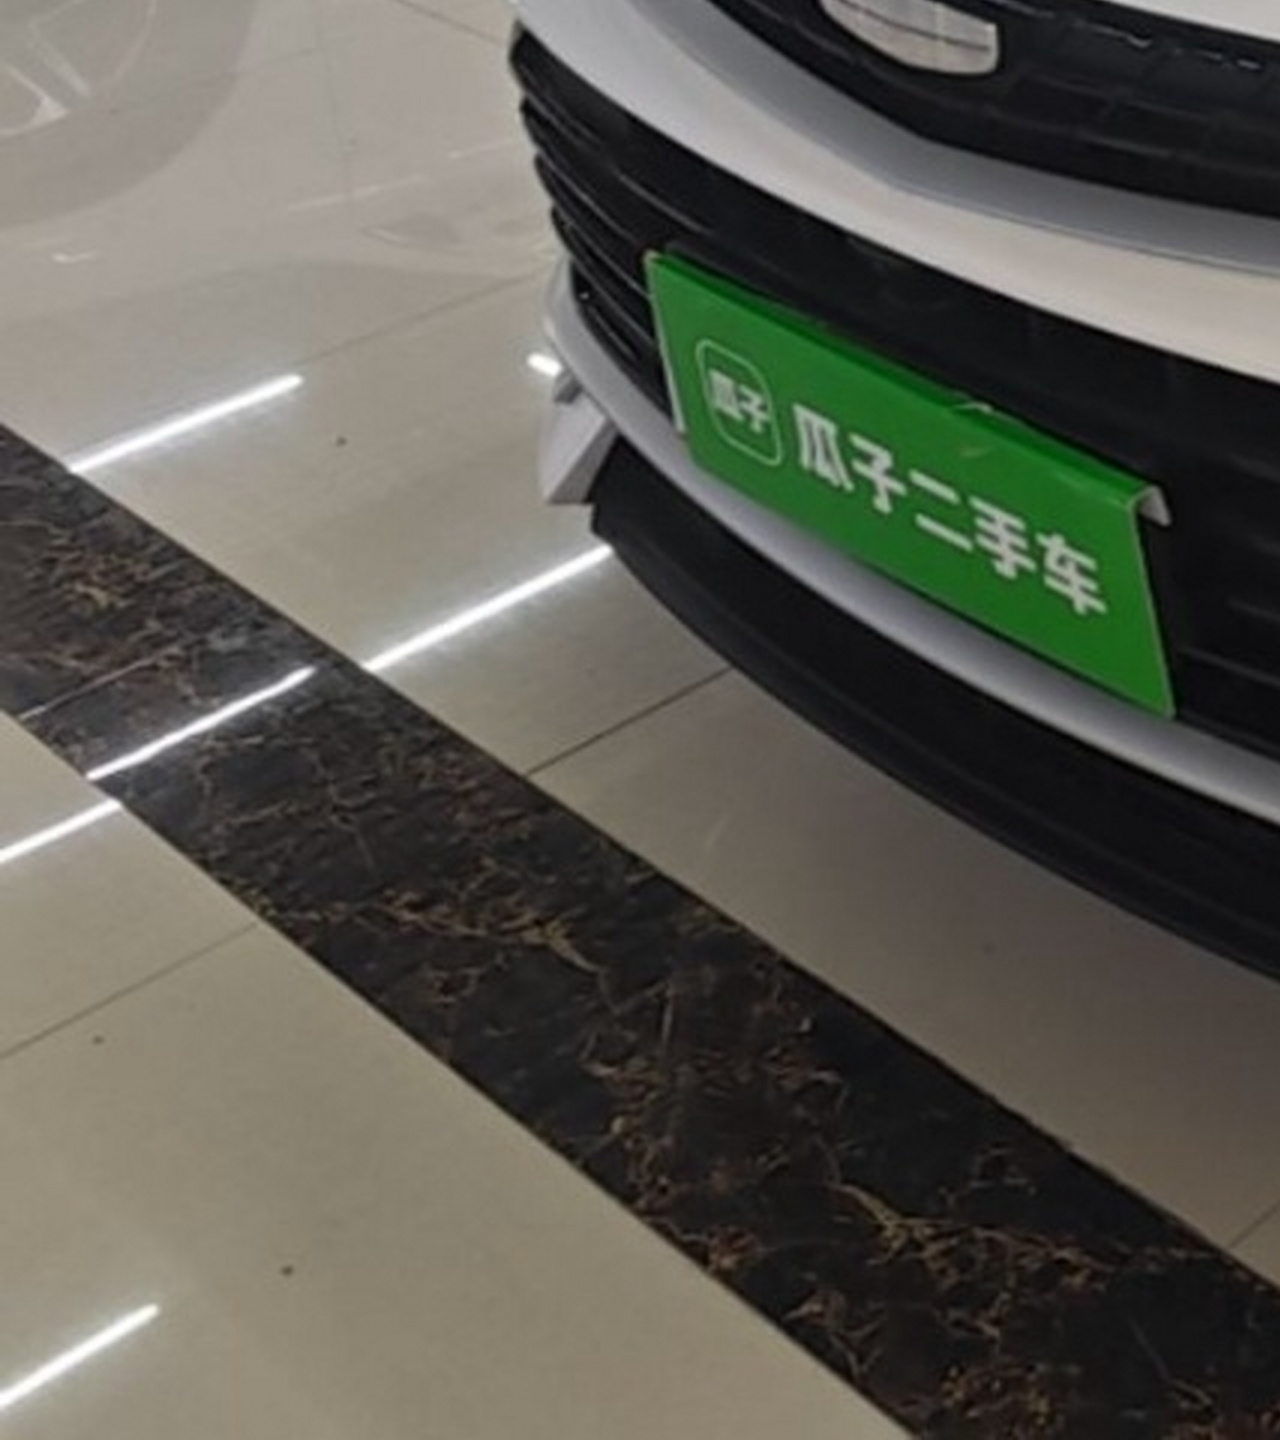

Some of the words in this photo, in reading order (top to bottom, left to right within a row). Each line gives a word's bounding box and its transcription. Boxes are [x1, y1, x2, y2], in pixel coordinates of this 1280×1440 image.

[708, 368, 771, 434] 瓜子
[793, 402, 1108, 616] 瓜子二手车
